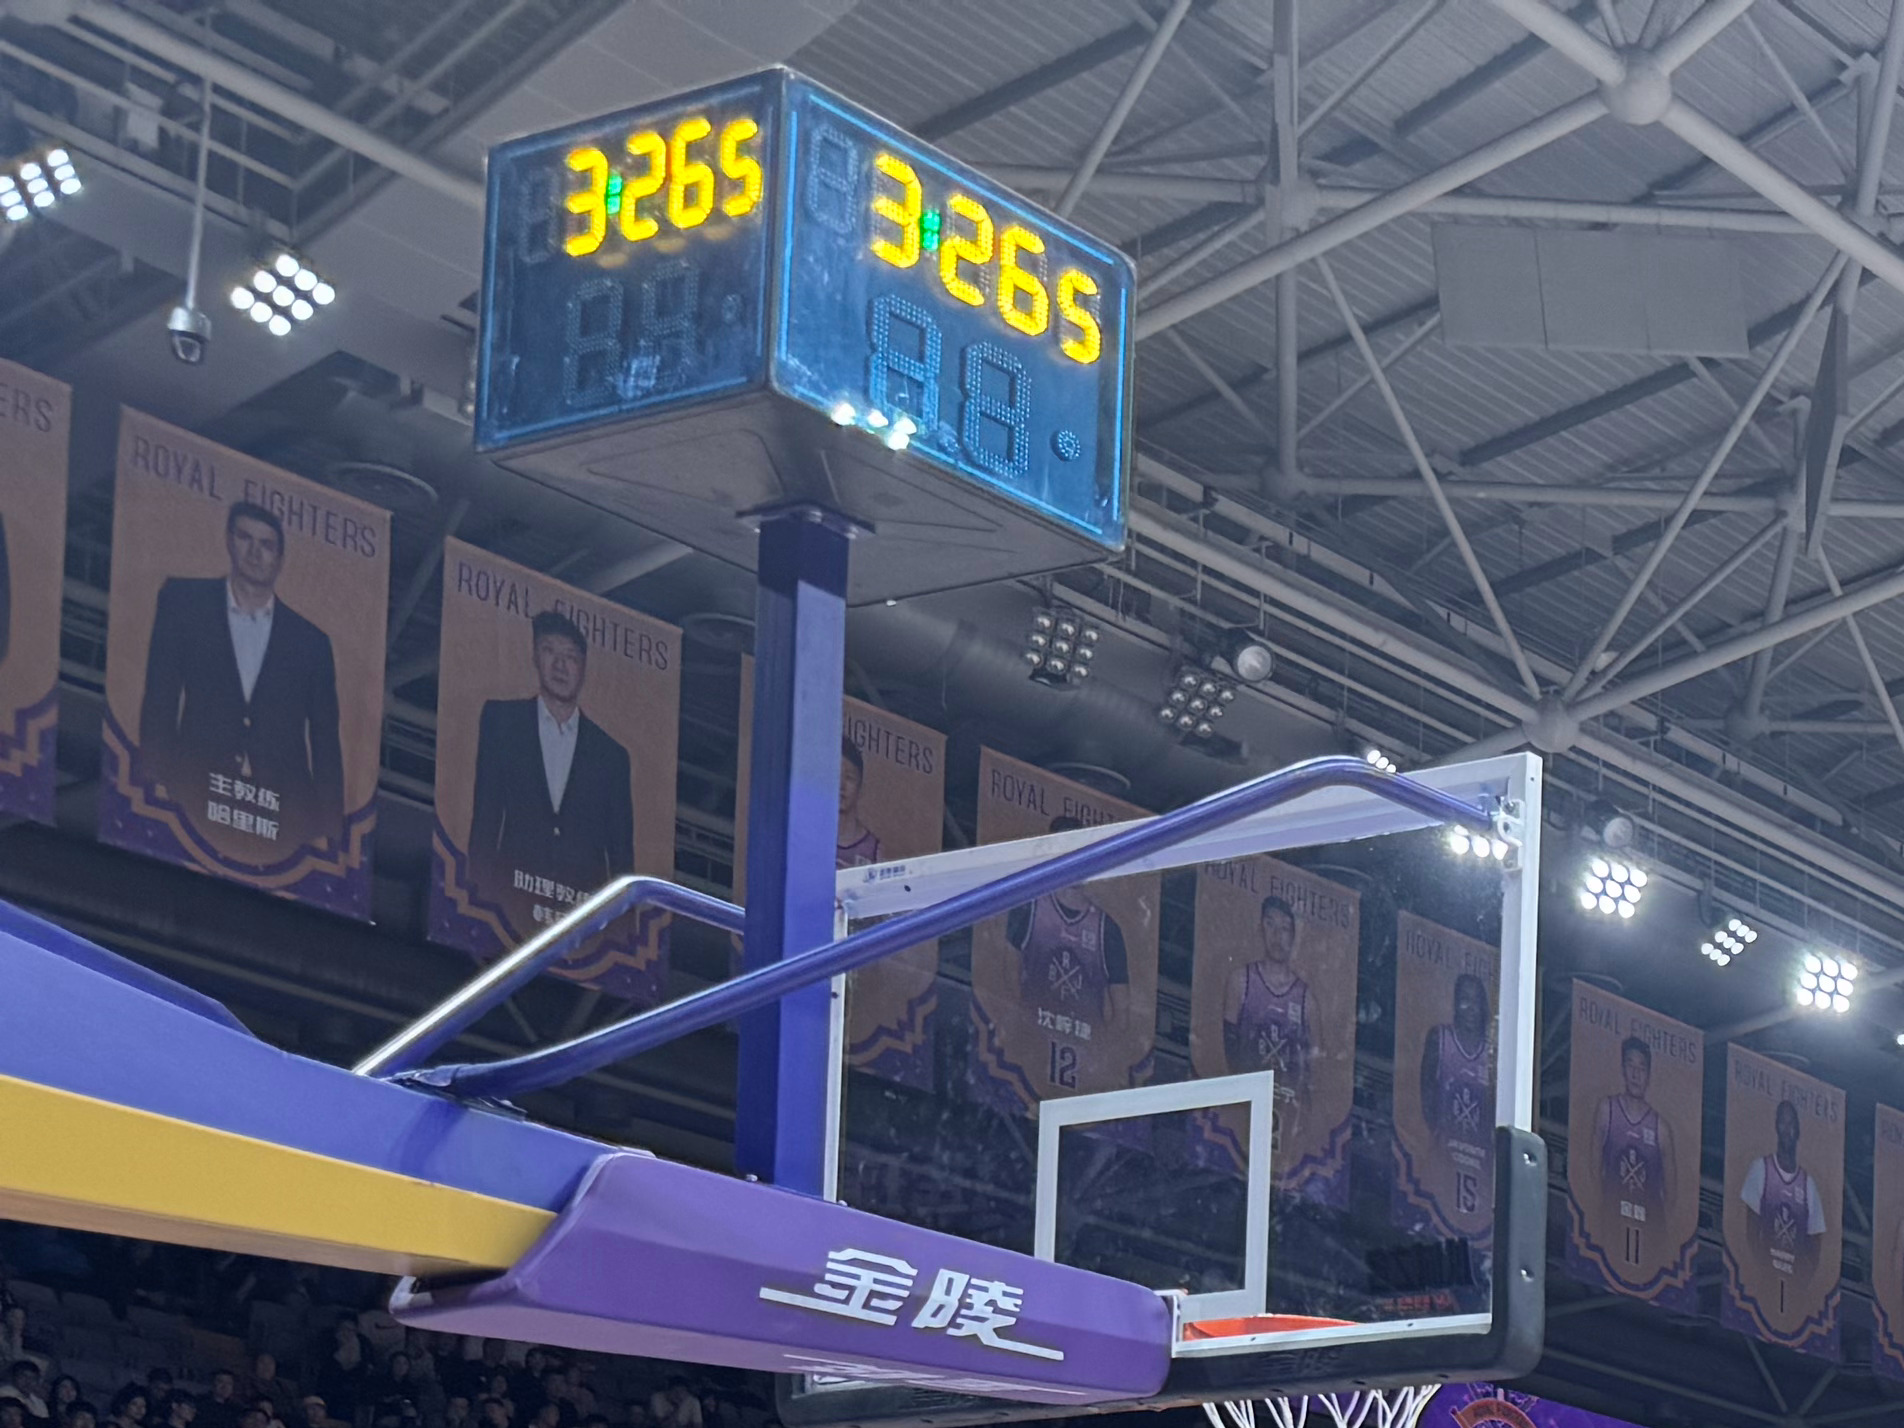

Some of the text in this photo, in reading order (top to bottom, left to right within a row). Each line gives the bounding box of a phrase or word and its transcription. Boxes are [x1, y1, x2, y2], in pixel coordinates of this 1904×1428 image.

[134, 435, 376, 558] ROYAL FIGHTERS
[458, 561, 669, 671] ROYAL FIGHTERS
[209, 773, 280, 812] 主教练
[992, 770, 1049, 816] ROYAL
[207, 800, 280, 840] 哈里斯
[1051, 1041, 1077, 1088] 12
[1456, 1172, 1477, 1213] 15
[759, 1248, 1064, 1361] 金陵
